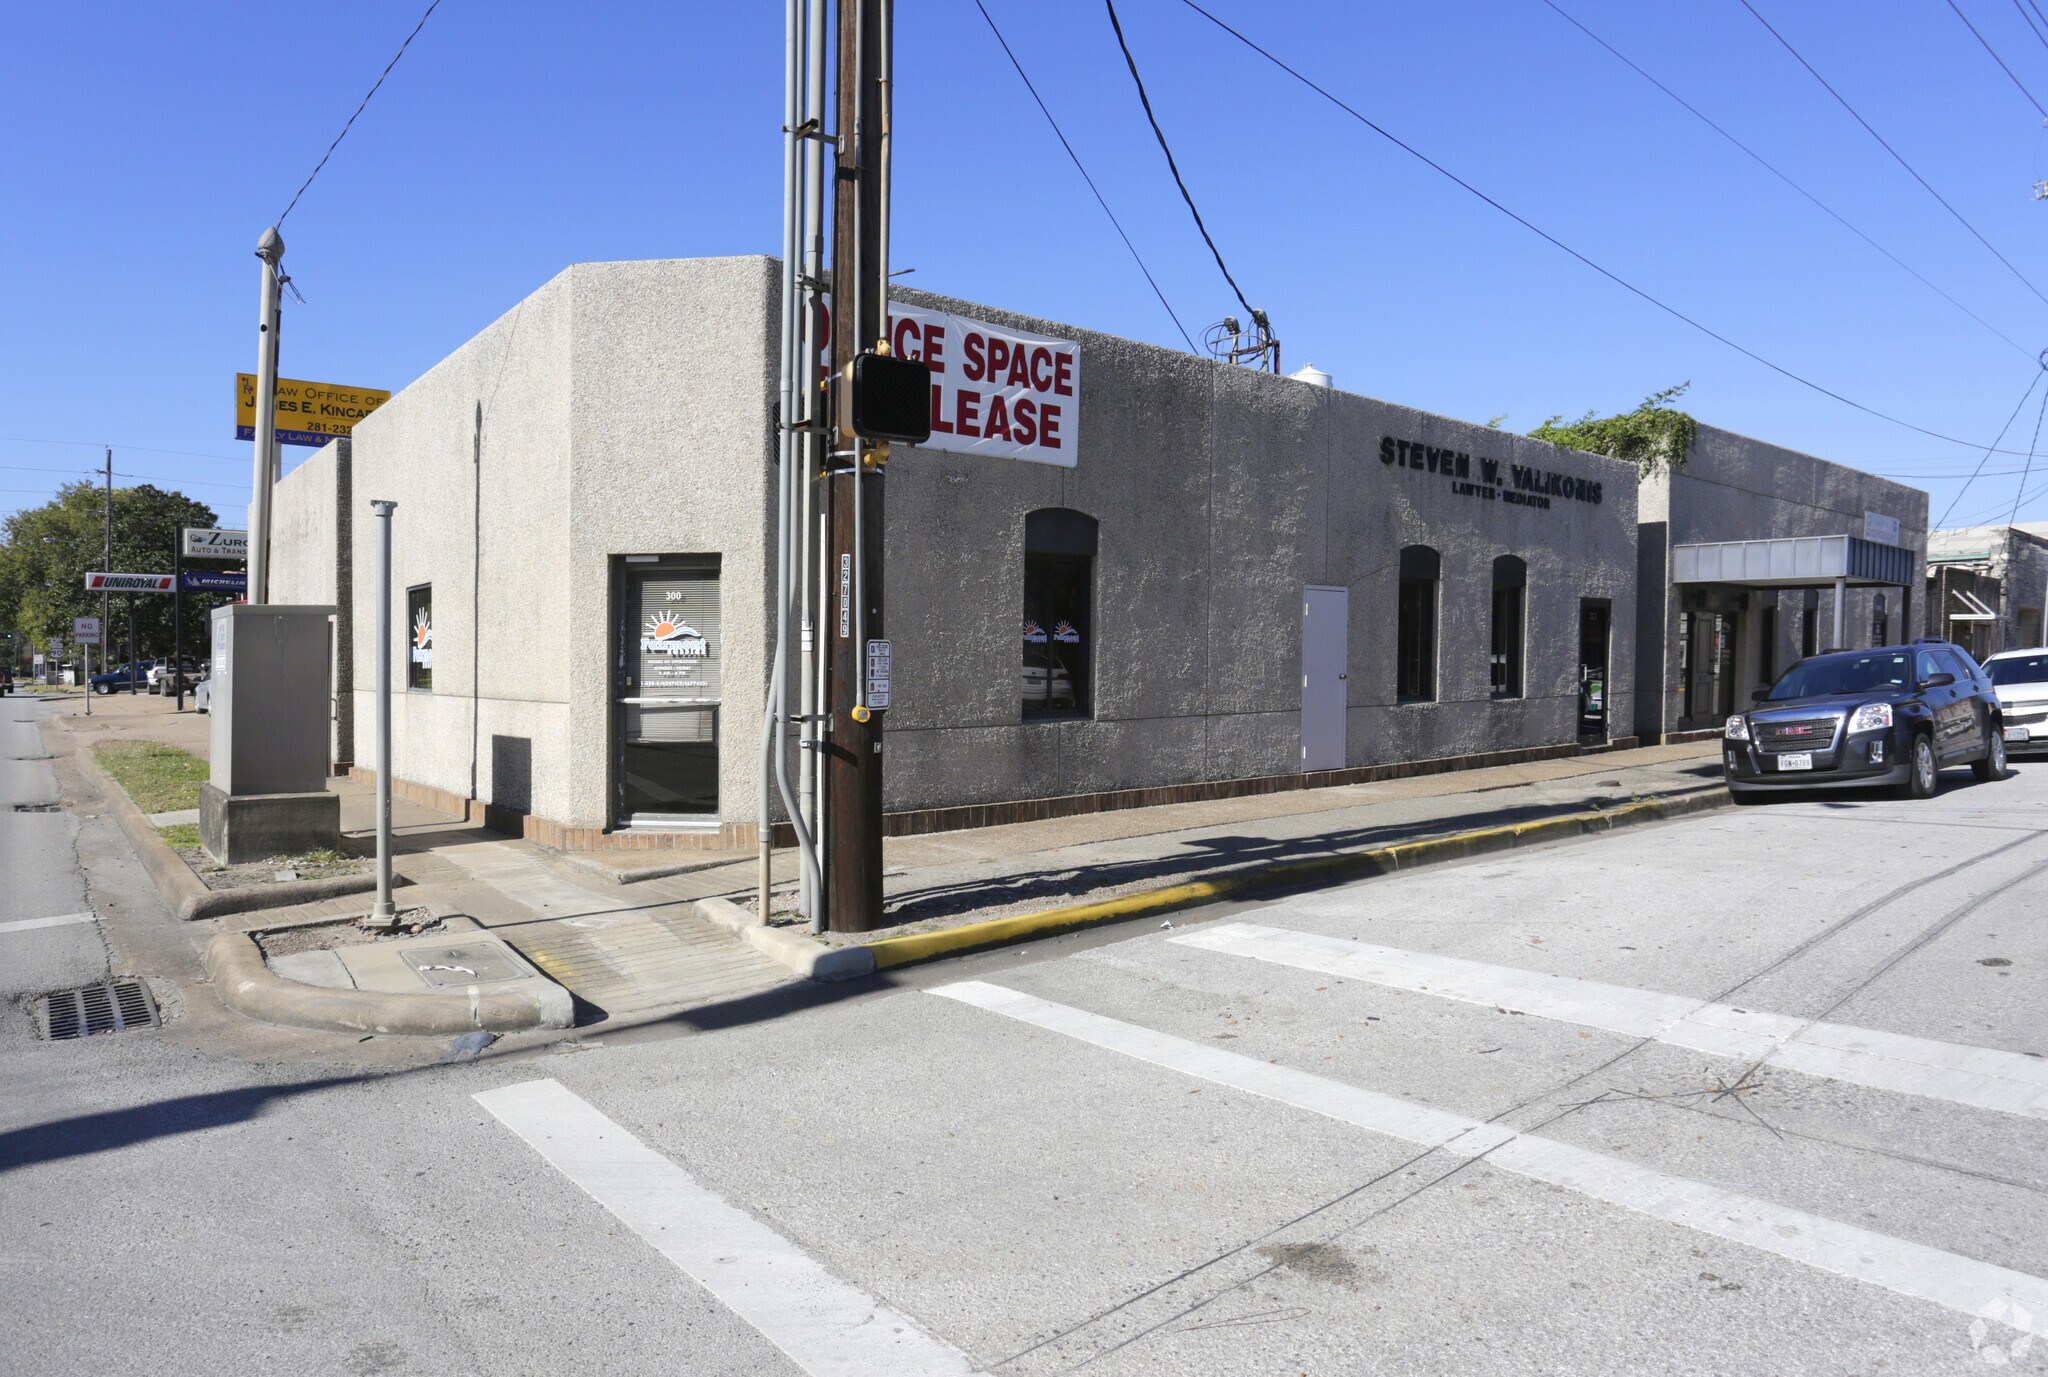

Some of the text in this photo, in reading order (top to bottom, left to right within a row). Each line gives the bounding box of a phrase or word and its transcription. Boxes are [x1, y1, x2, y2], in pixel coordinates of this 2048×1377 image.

[963, 332, 1073, 397] SPACE
[245, 395, 298, 412] JES
[301, 401, 316, 414] E.
[276, 387, 385, 406] AW OFFICE OF
[931, 384, 1061, 449] LEASE
[288, 432, 312, 443] LAW
[1379, 437, 1603, 505] STEVEN W. VALIKONIS
[1452, 481, 1496, 500] LAWYER
[1503, 490, 1551, 509] MEDIATOR
[191, 546, 211, 554] AUTO
[104, 577, 158, 589] UNIROYAL
[201, 578, 246, 586] MICHELIN
[665, 591, 682, 601] 300
[841, 556, 849, 636] 327049
[640, 637, 706, 651] Fairmont
[1775, 726, 1812, 736] GMC
